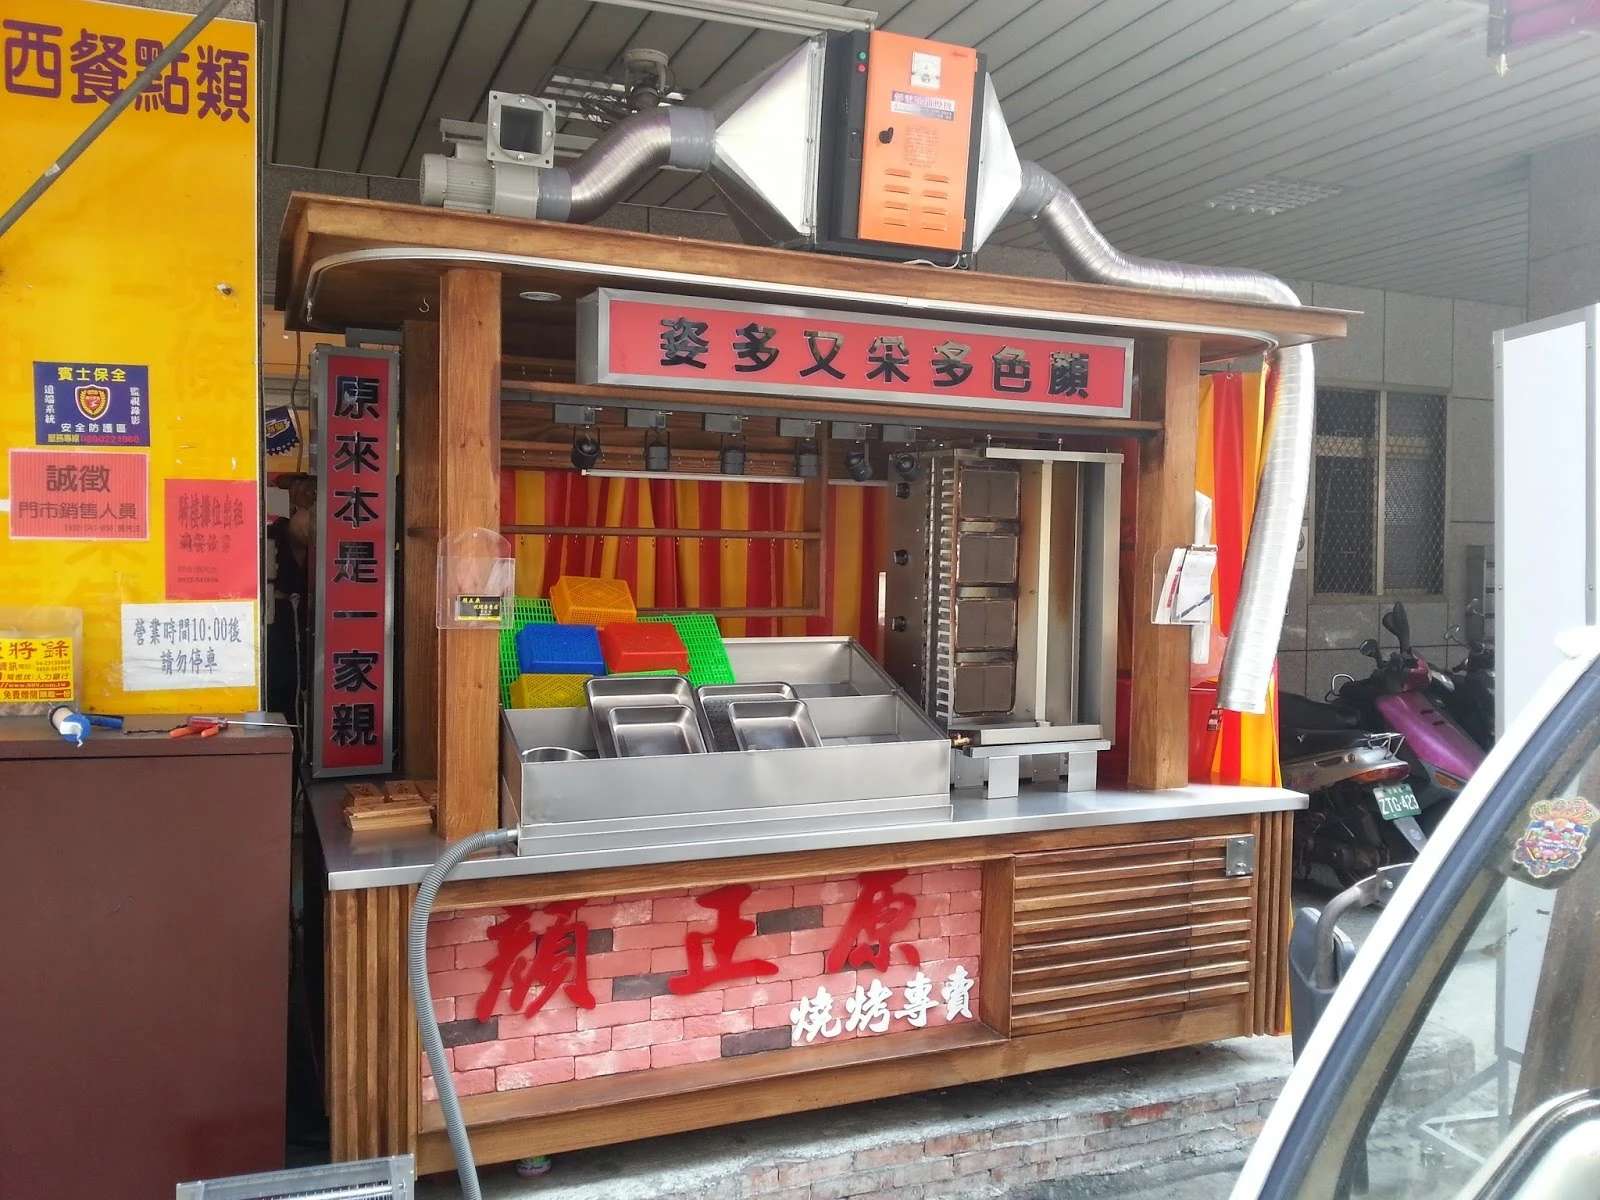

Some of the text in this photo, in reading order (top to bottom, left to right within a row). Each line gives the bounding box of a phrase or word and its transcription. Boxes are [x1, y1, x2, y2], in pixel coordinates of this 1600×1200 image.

[3, 18, 251, 124] 西餐點類
[57, 366, 127, 382] 賓士保全
[60, 422, 127, 433] 安全防護區
[46, 465, 111, 493] 誠徵
[19, 501, 138, 520] 門市銷售人員
[332, 375, 380, 748] 原來本是一家親
[133, 617, 242, 645] 營業時間10:00後
[160, 646, 218, 675] 請勿停車
[789, 964, 975, 1042] 燒烤專賣
